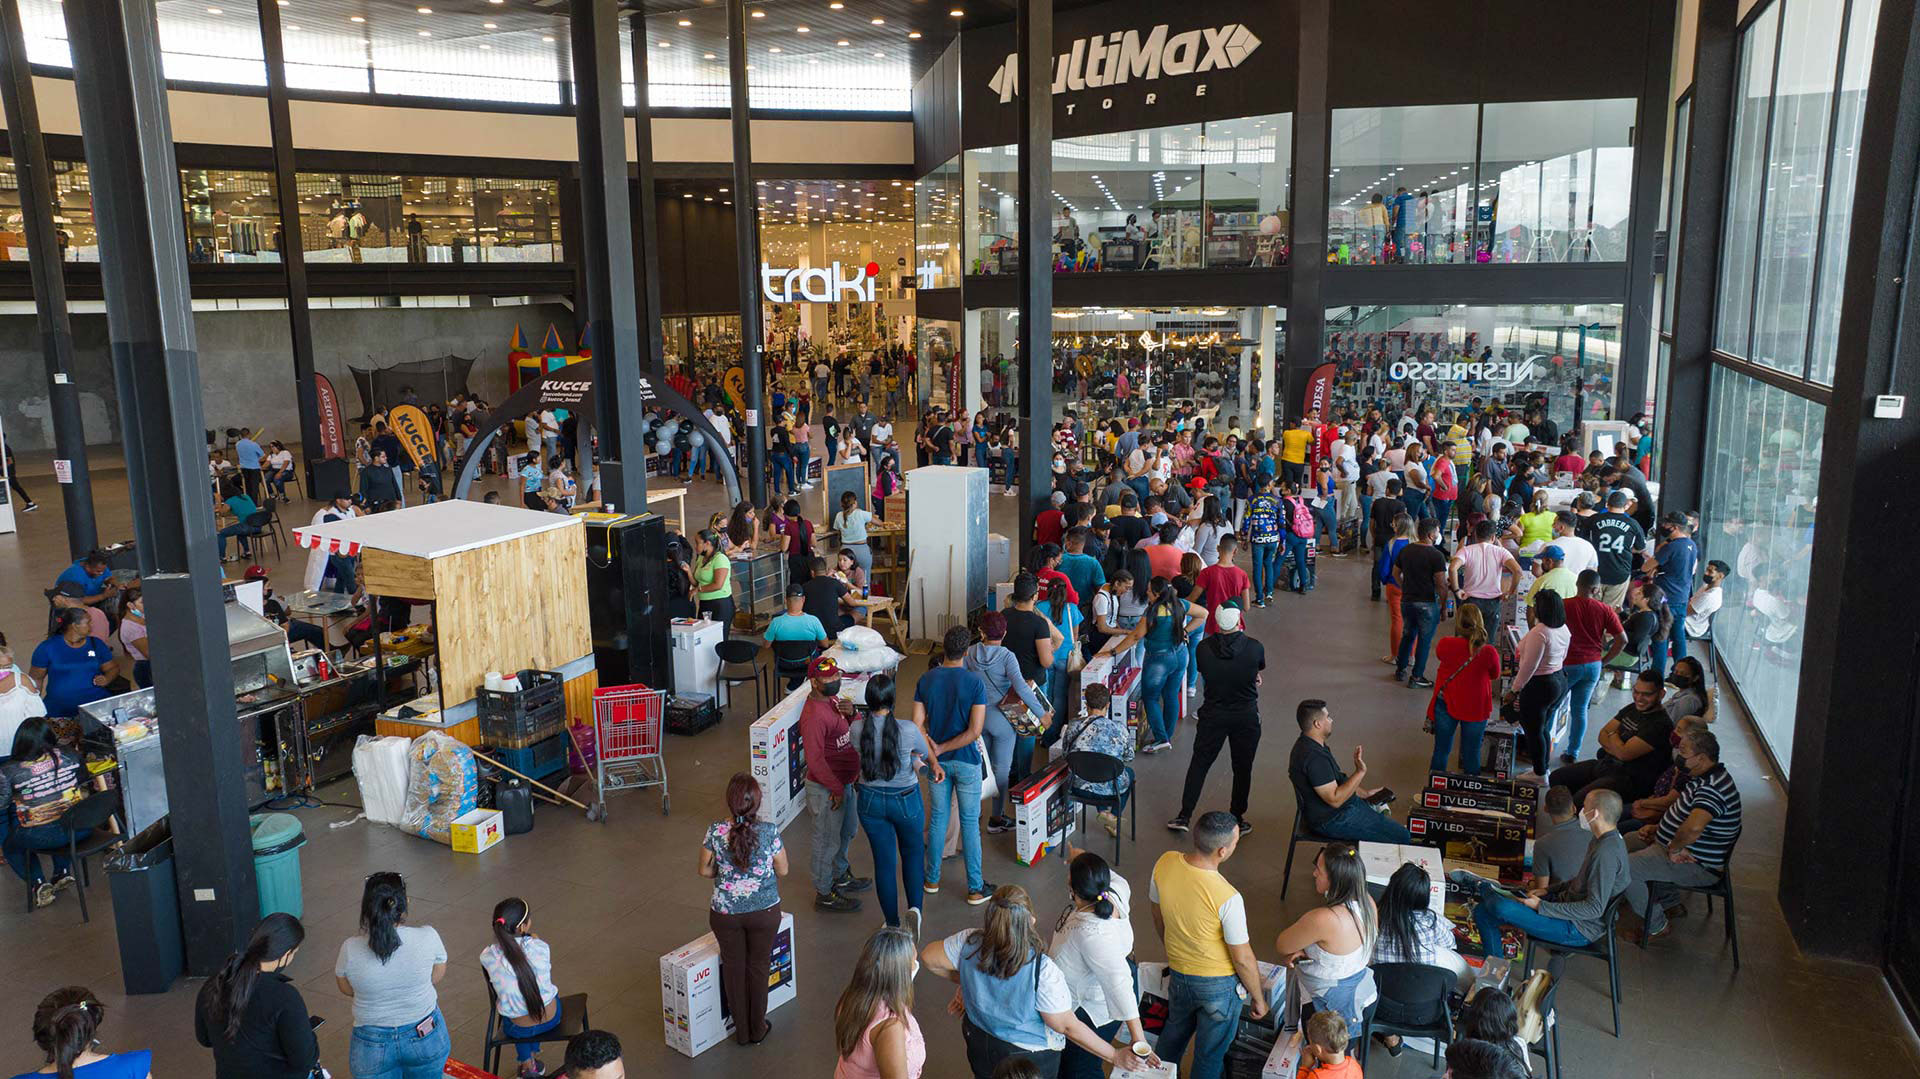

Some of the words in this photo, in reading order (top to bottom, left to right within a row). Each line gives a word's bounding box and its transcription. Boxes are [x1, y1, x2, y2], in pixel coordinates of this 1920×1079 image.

[1066, 84, 1207, 115] TORE
[761, 261, 880, 303] traki
[540, 380, 593, 392] KUCCE
[1596, 519, 1631, 533] CABRERA
[1599, 533, 1625, 554] 24
[772, 728, 785, 749] JVC
[753, 765, 769, 777] 58
[1450, 778, 1462, 788] TV
[1463, 781, 1482, 790] LED
[1519, 787, 1535, 798] 32
[1443, 795, 1455, 804] TV
[1457, 798, 1477, 807] LED
[1514, 804, 1530, 816] 32
[1430, 821, 1443, 831] TV
[1444, 823, 1464, 833] LED
[1504, 829, 1521, 841] 32
[1445, 883, 1460, 893] ED
[694, 967, 711, 983] JVC
